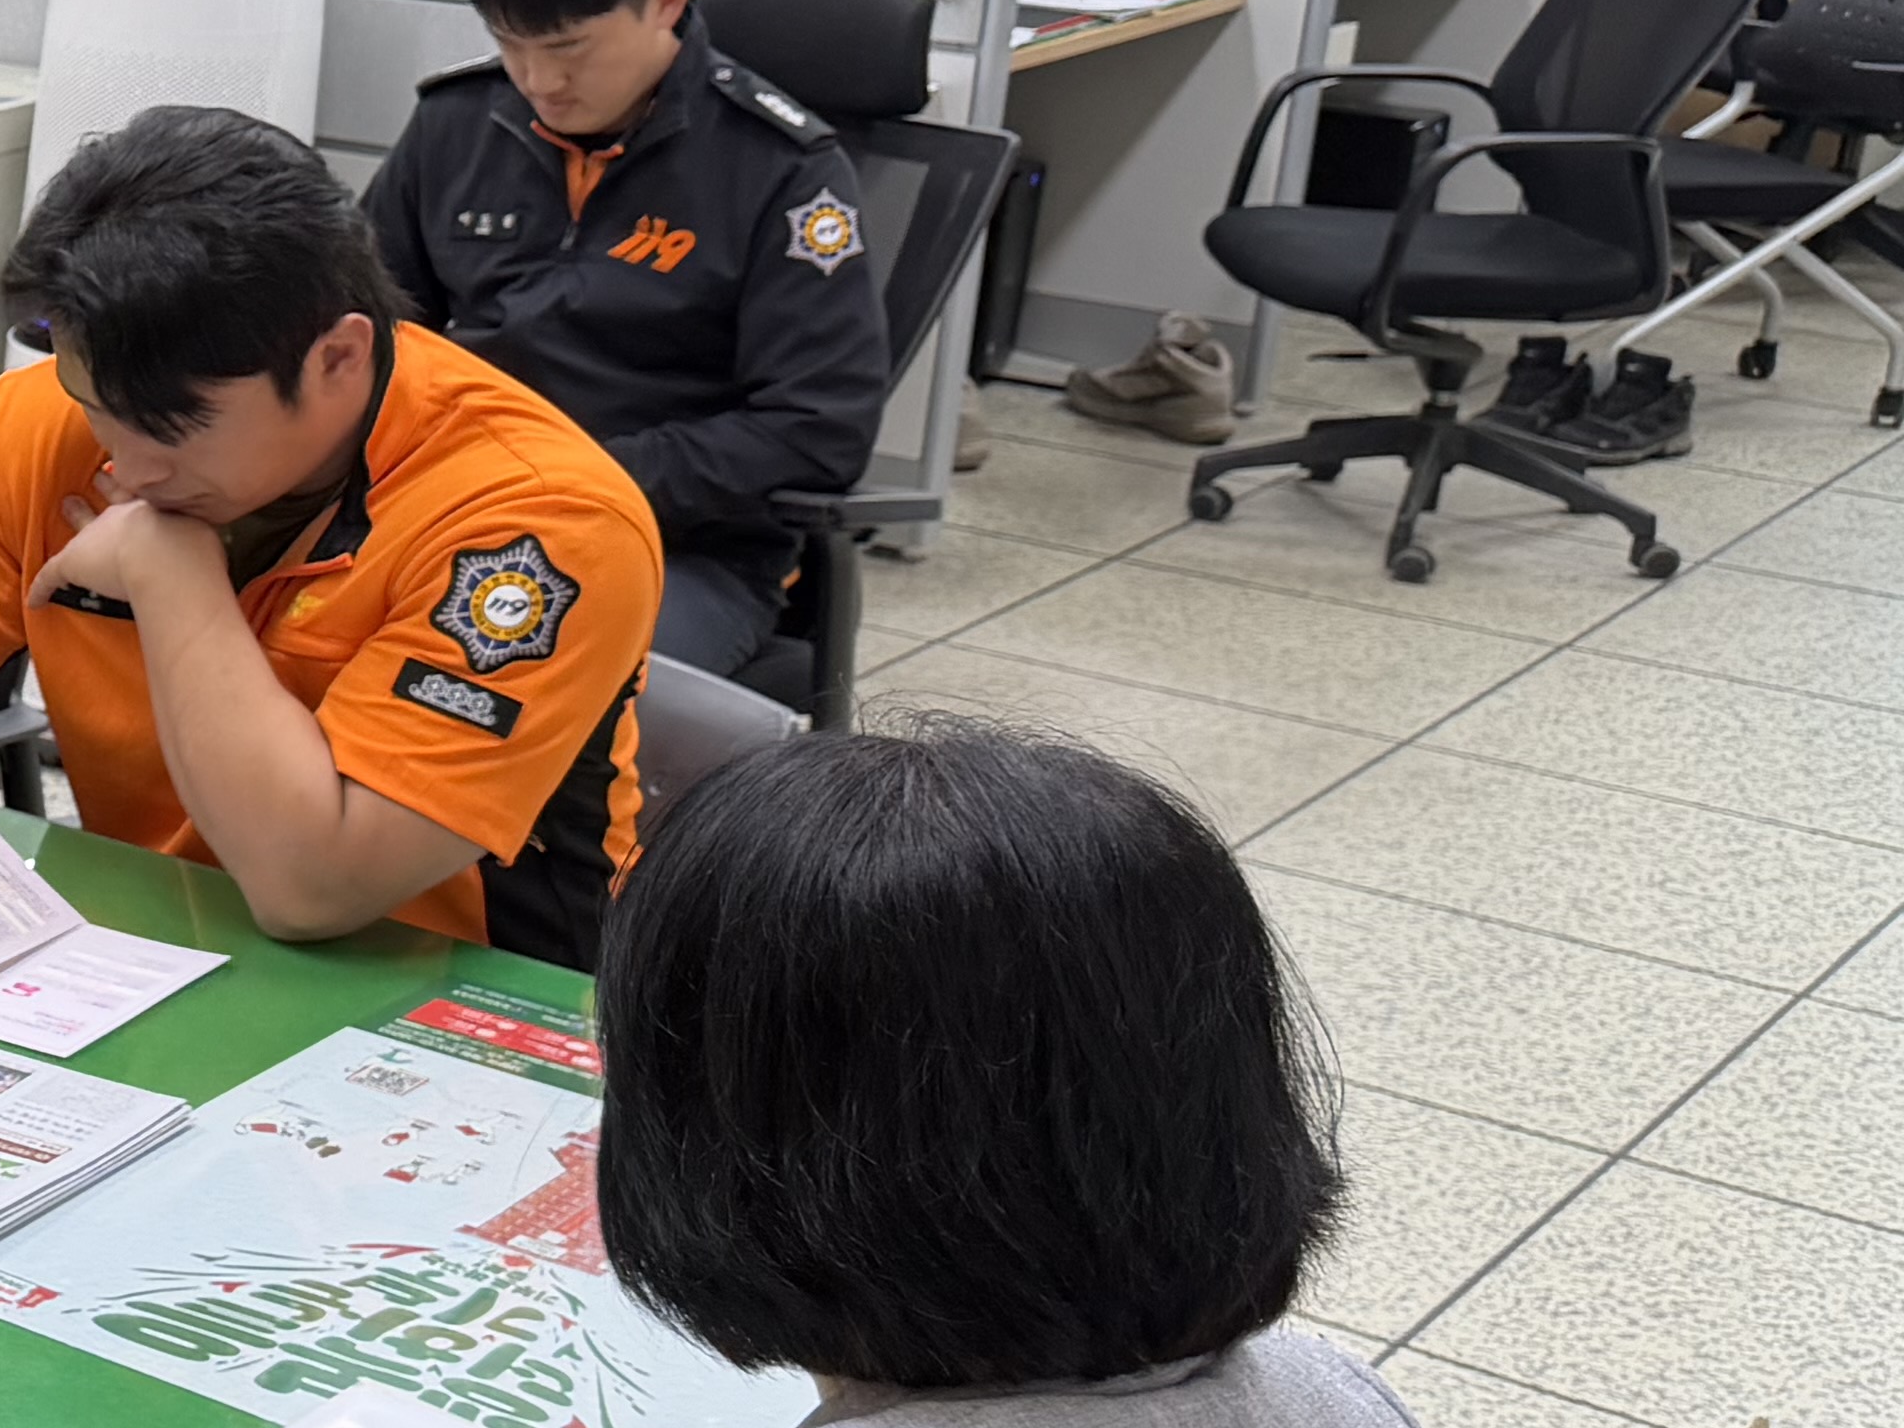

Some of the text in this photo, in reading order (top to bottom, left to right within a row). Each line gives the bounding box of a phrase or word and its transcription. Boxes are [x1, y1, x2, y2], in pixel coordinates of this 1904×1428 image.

[607, 215, 695, 273] 119
[487, 596, 529, 616] 119
[345, 1265, 549, 1343] 기부
[255, 1276, 576, 1410] 더하는
